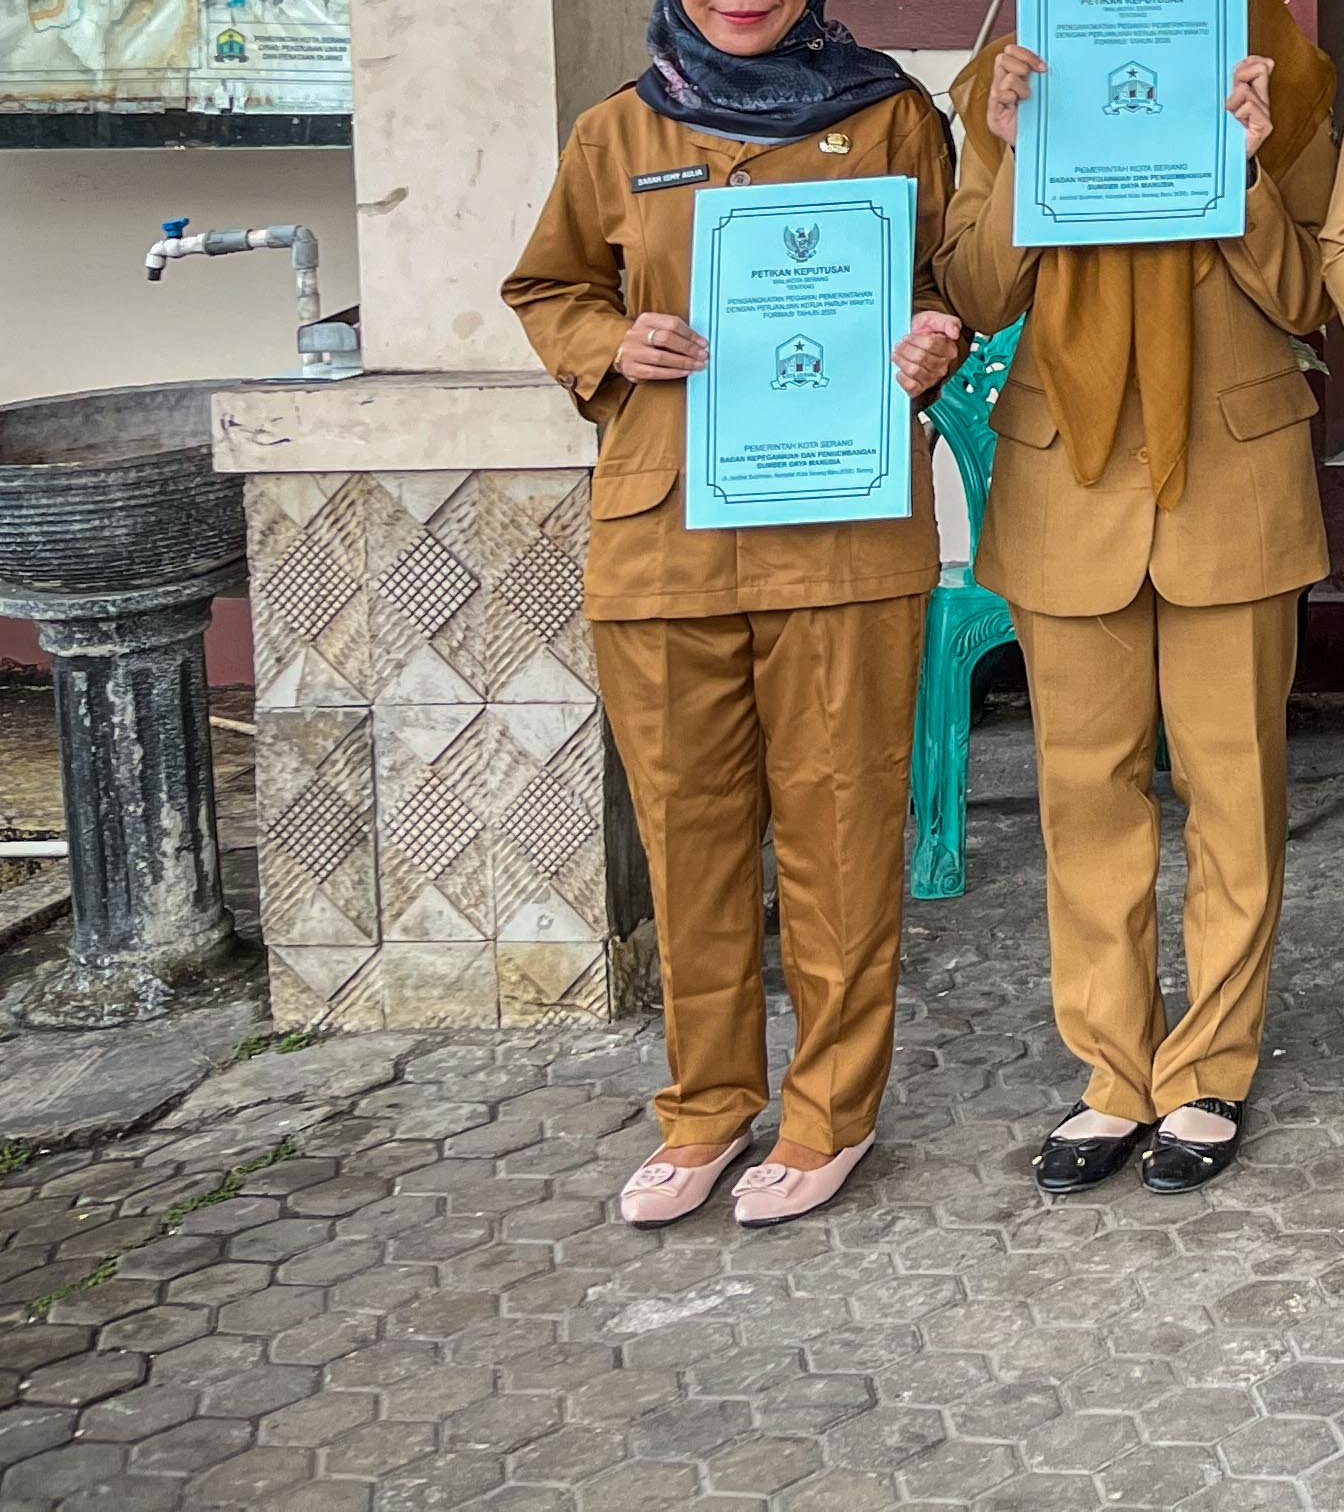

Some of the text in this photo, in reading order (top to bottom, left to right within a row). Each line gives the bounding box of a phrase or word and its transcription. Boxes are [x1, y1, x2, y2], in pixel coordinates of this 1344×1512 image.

[752, 264, 850, 279] PETIKAN KEPUTUSAN
[744, 443, 796, 452] PEMERINTAH
[820, 440, 853, 448] SERANG
